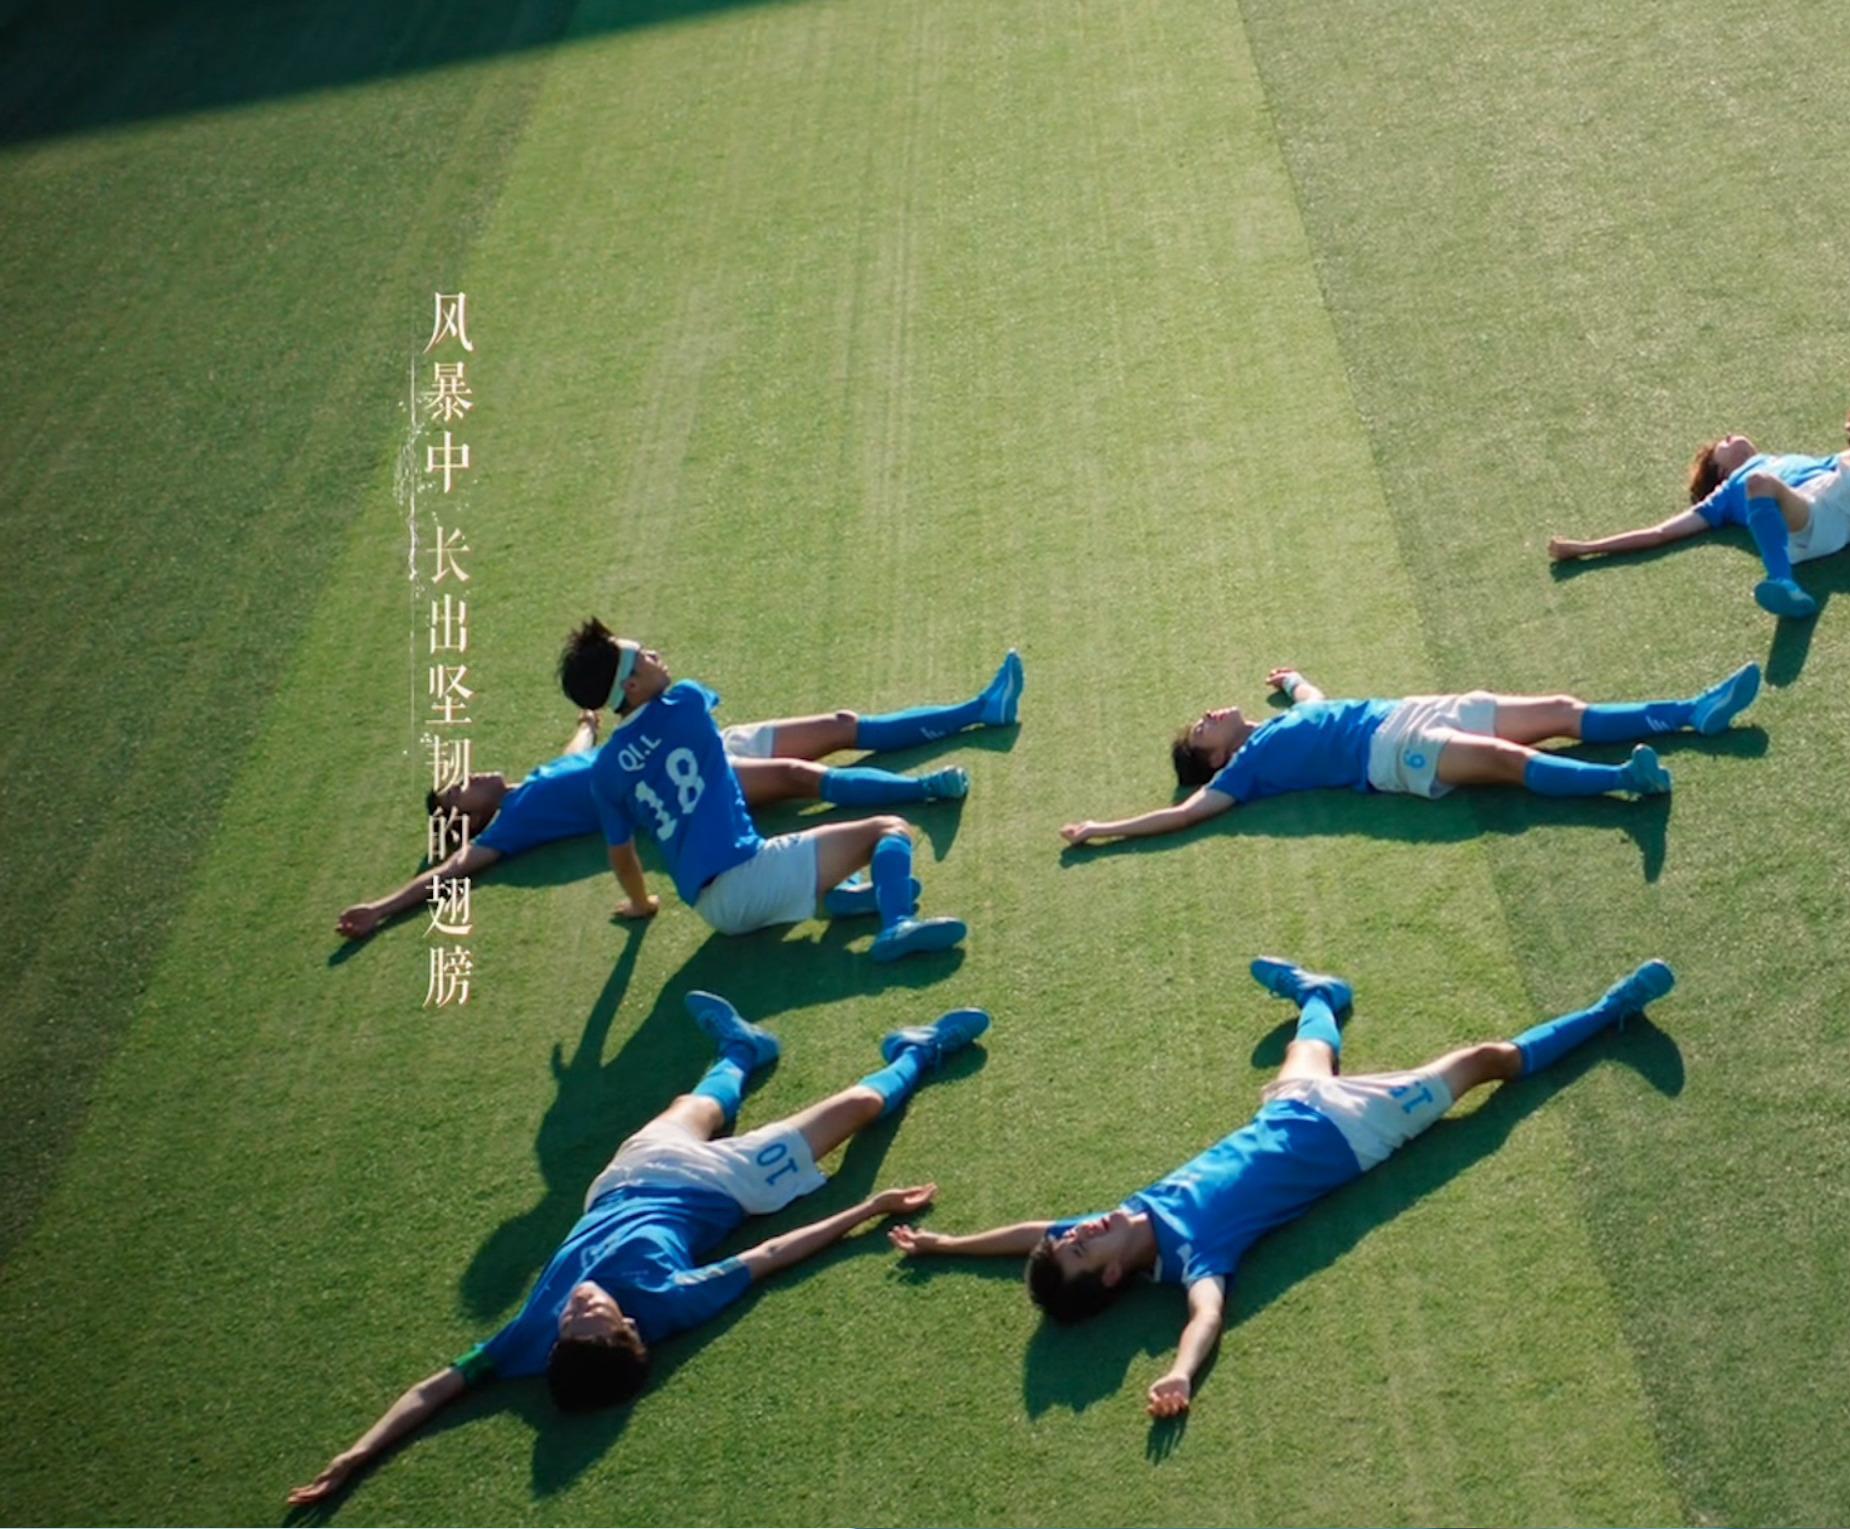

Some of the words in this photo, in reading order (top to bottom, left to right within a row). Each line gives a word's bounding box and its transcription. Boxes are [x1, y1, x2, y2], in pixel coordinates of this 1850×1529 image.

[618, 734, 661, 772] QI.L
[635, 747, 705, 841] 18
[757, 1143, 798, 1186] 10
